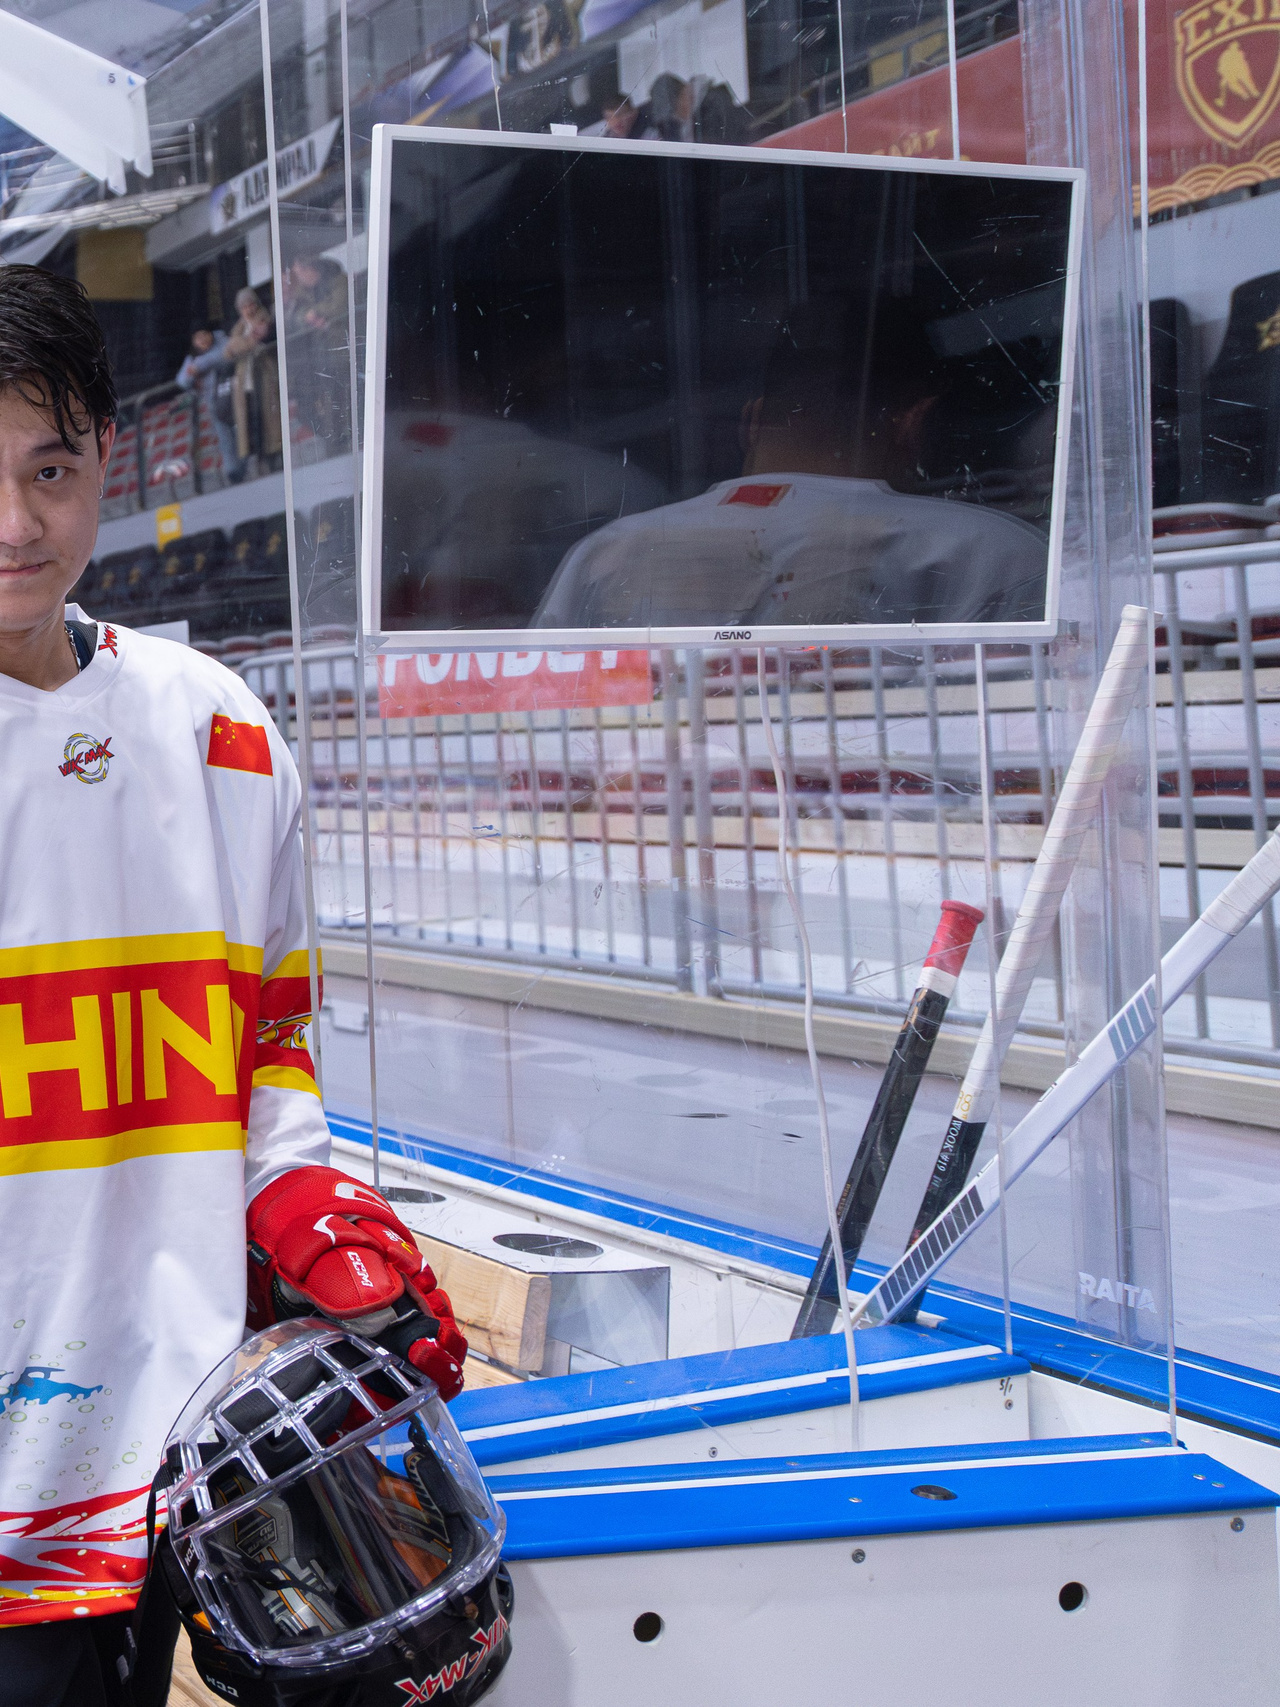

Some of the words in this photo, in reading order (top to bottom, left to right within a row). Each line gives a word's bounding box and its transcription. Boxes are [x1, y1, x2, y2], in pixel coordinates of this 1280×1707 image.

[108, 72, 116, 84] 5
[713, 631, 752, 640] ASANO
[58, 736, 115, 777] VIK-MAX
[347, 1251, 374, 1288] CCM
[1078, 1271, 1158, 1314] RAITA
[394, 1609, 508, 1707] VIK-MAX
[205, 1674, 239, 1697] CCM
